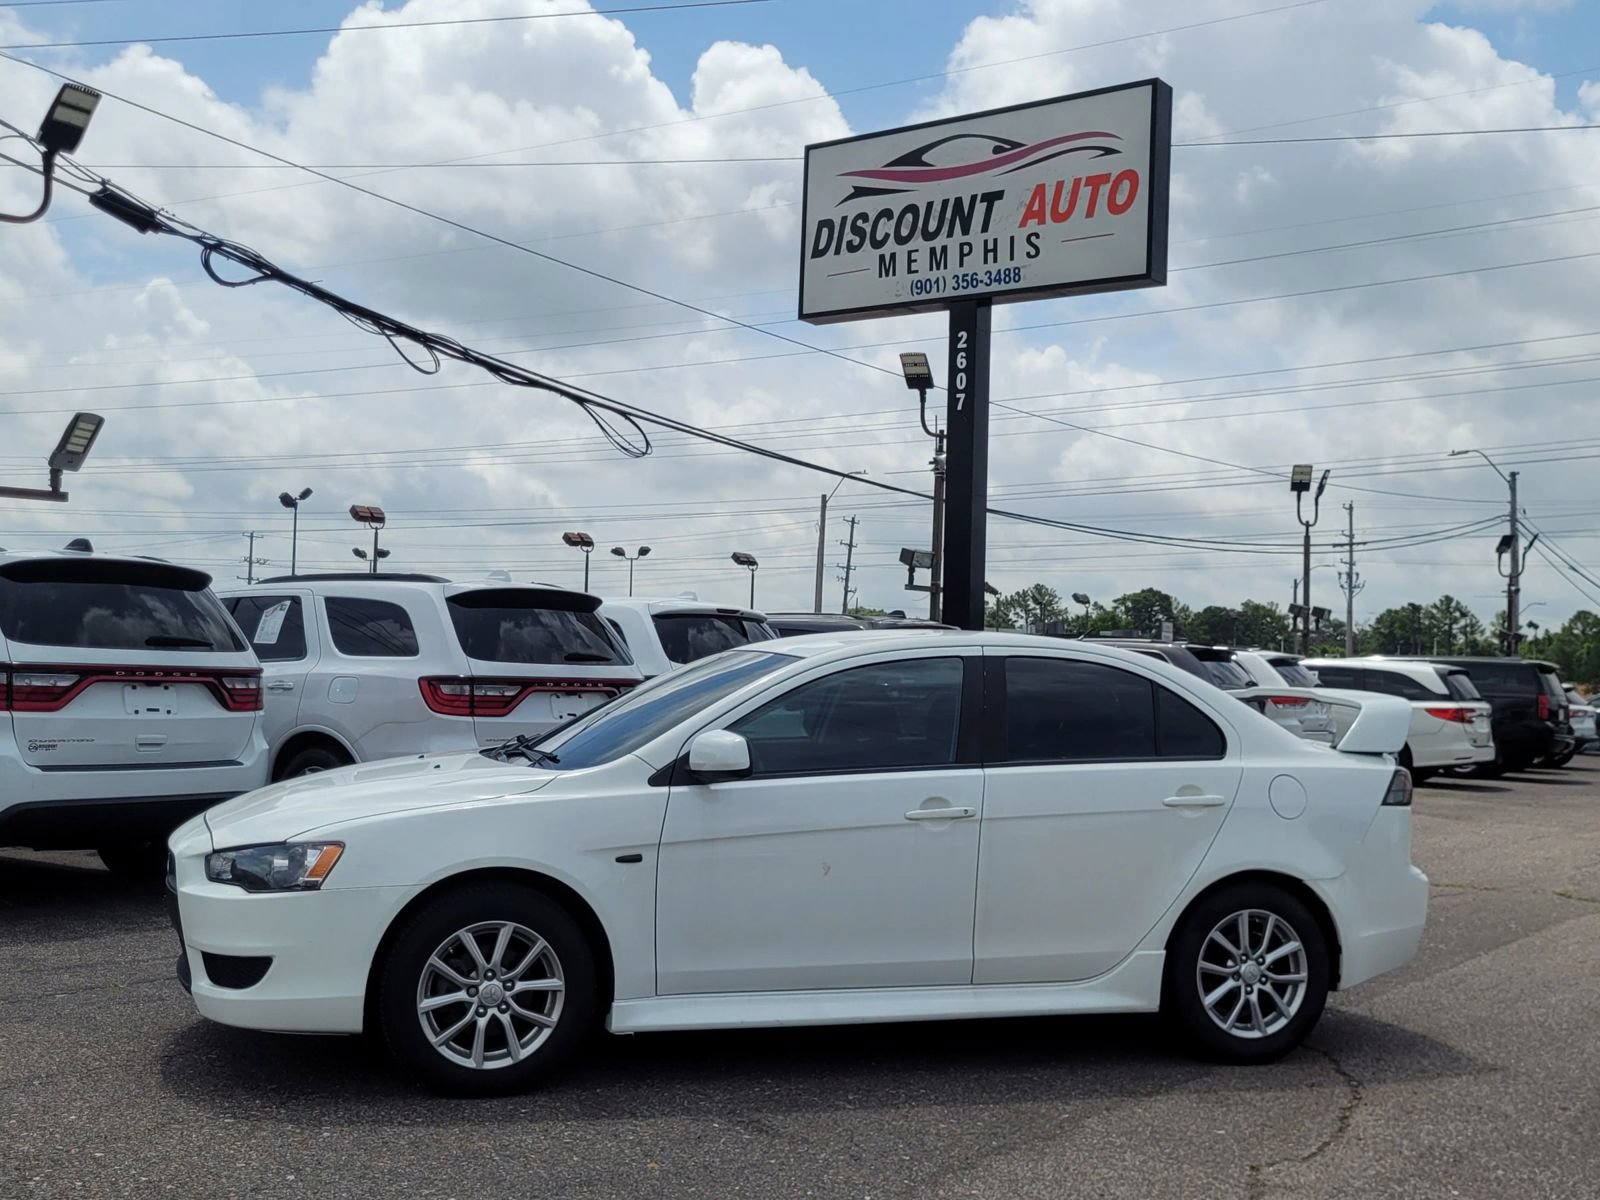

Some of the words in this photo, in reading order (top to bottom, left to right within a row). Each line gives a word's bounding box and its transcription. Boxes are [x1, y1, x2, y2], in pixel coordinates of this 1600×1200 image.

[810, 190, 1005, 259] DISCOUNT
[1018, 168, 1139, 228] AUTO
[878, 232, 1040, 278] MEMPHIS
[910, 276, 947, 296] (901)
[952, 267, 1021, 291] 356-3488
[955, 331, 968, 411] 2607
